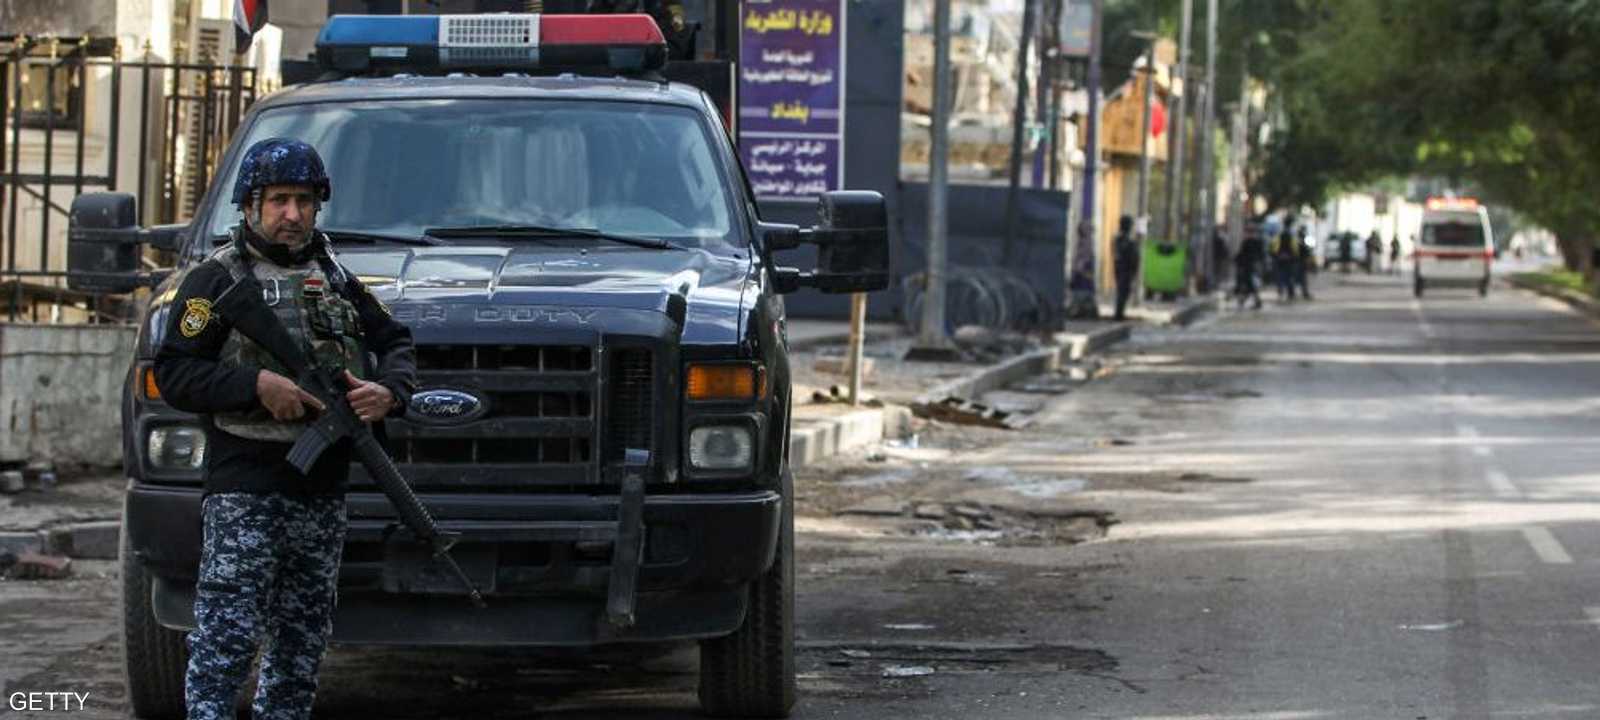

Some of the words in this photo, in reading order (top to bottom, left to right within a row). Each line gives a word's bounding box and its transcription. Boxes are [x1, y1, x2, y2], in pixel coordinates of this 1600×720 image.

[745, 8, 797, 33] الكهرباء
[800, 9, 832, 34] وزارة
[771, 100, 810, 124] بغداد
[474, 305, 599, 324] DUTY
[421, 395, 464, 415] Ford
